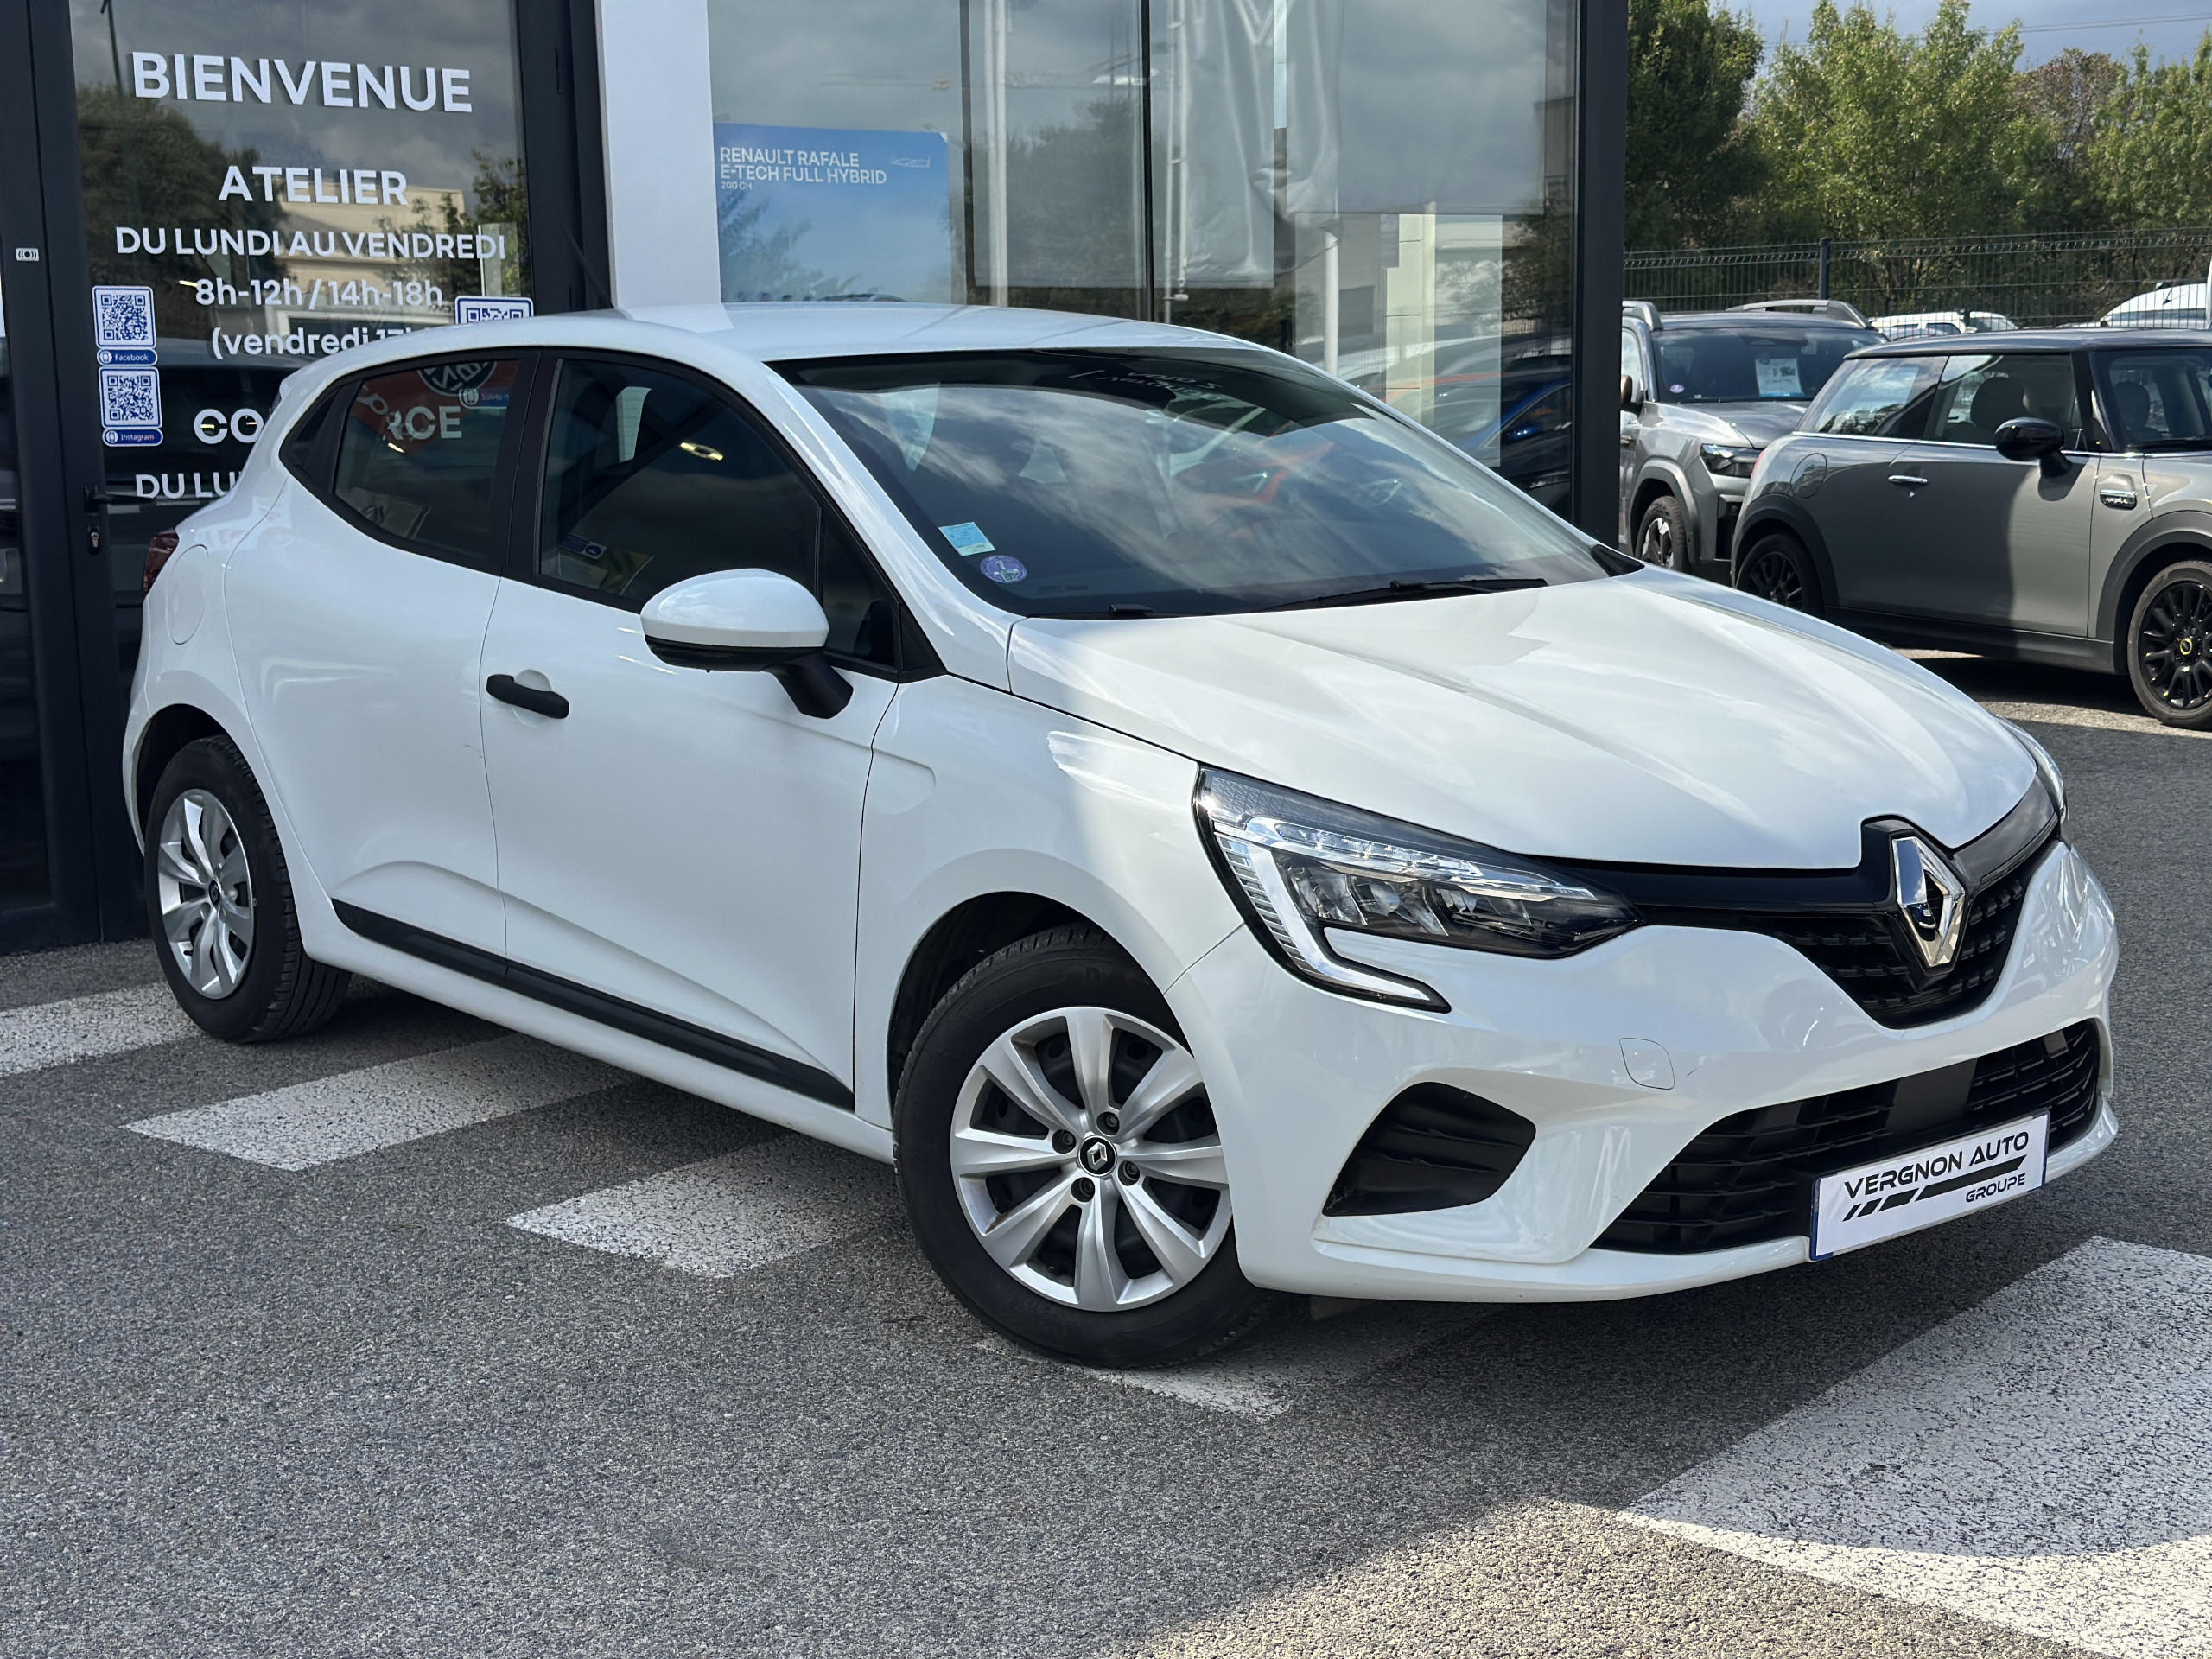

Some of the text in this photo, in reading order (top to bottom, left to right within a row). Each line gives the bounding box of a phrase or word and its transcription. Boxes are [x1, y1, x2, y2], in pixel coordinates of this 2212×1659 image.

[132, 51, 473, 113] BIENVENUE
[720, 146, 860, 168] RENAULT RAFALE
[219, 165, 409, 206] ATELIER
[720, 163, 887, 185] E-TECH FULL HYBRID
[721, 181, 738, 190] 200
[116, 226, 506, 259] DU LUNDI AU VENDREDI
[195, 277, 303, 306] 8h-12h
[327, 279, 444, 307] 14h-18h
[120, 433, 156, 442] Instagram
[135, 473, 186, 499] DU
[1844, 1131, 2029, 1199] VERGNON AUTO
[1965, 1173, 2026, 1204] GROUPE
